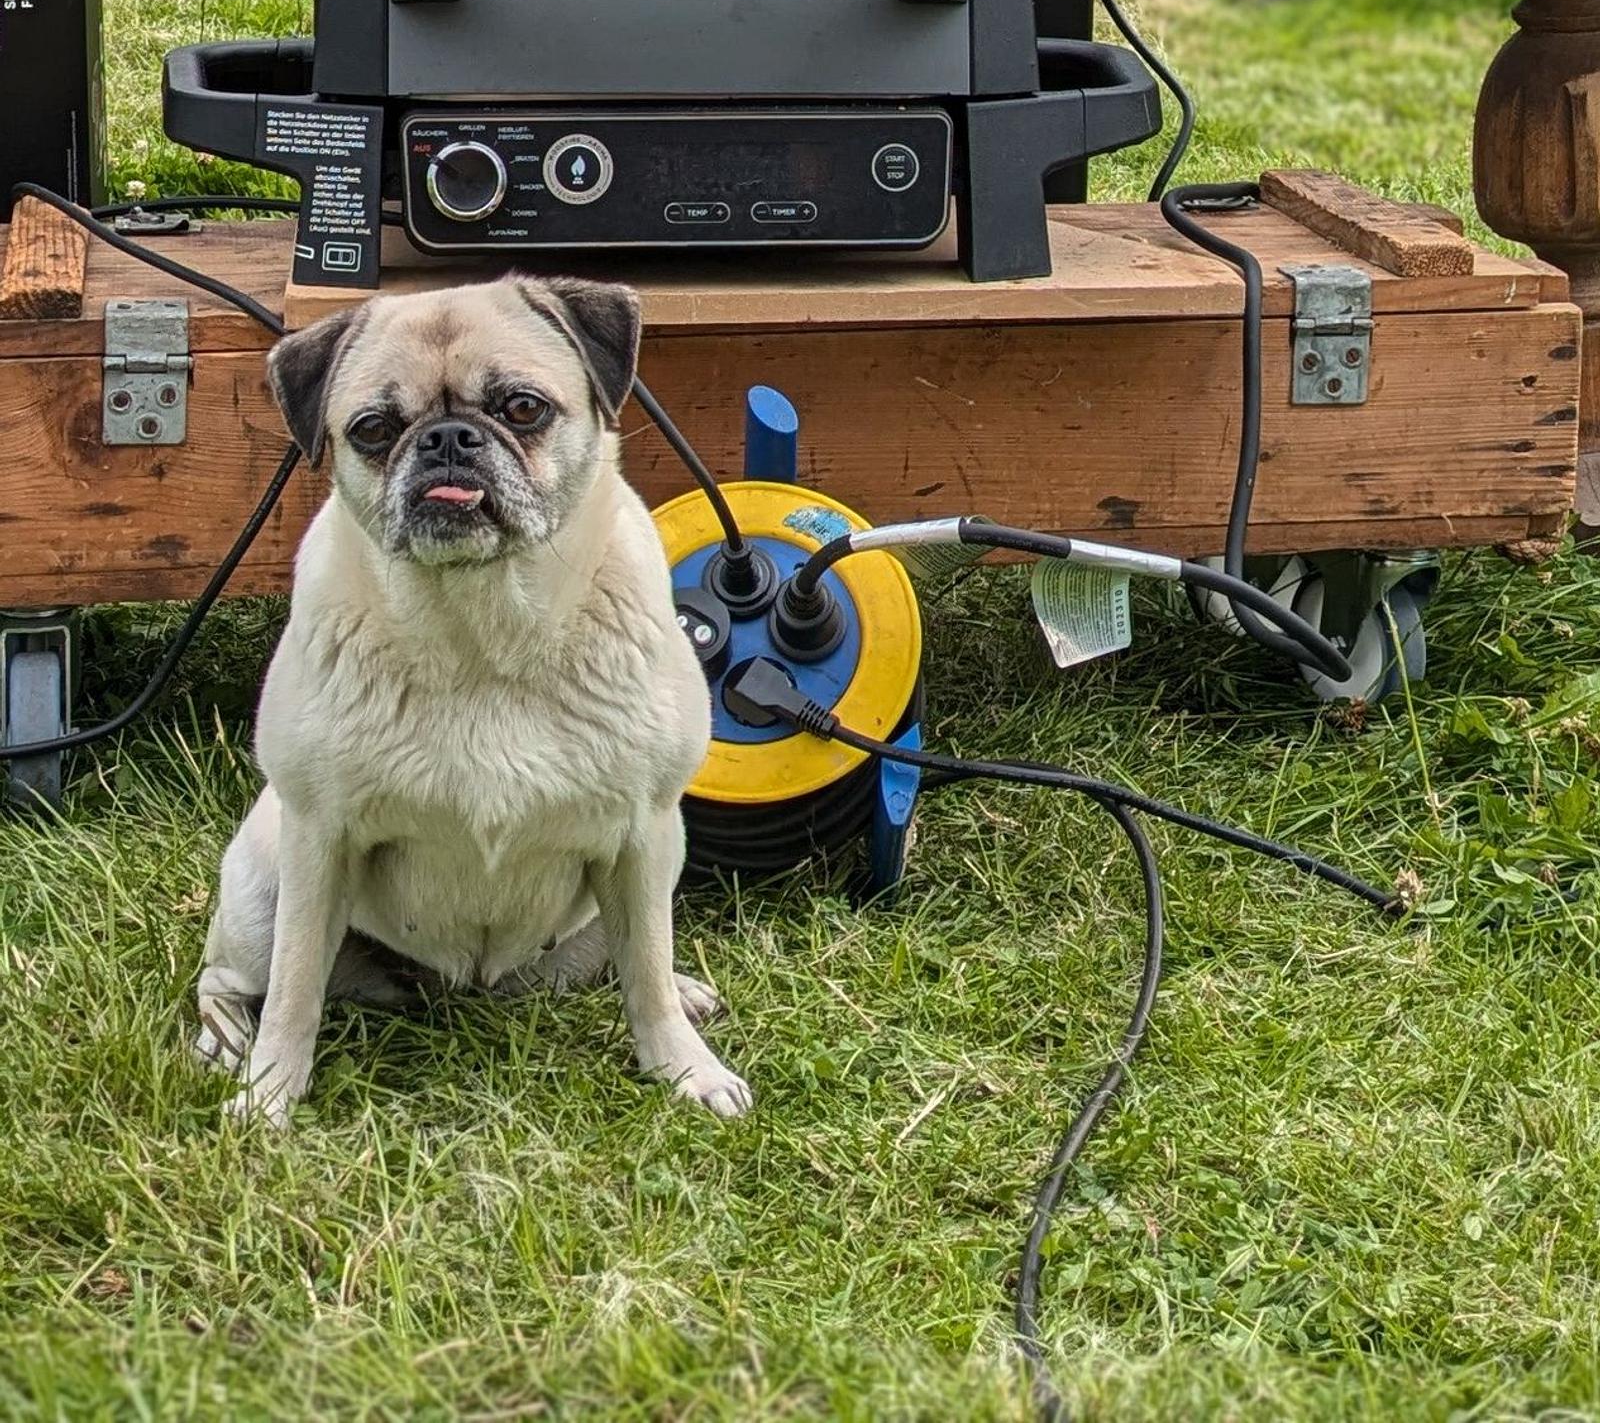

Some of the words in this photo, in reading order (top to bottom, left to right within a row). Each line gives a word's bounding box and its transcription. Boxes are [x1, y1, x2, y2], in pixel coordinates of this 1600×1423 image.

[413, 144, 432, 152] AUS
[885, 155, 906, 163] START
[886, 172, 905, 180] STOP
[687, 209, 709, 217] TEMP
[772, 208, 796, 216] TIMER
[1114, 589, 1126, 635] 202310
